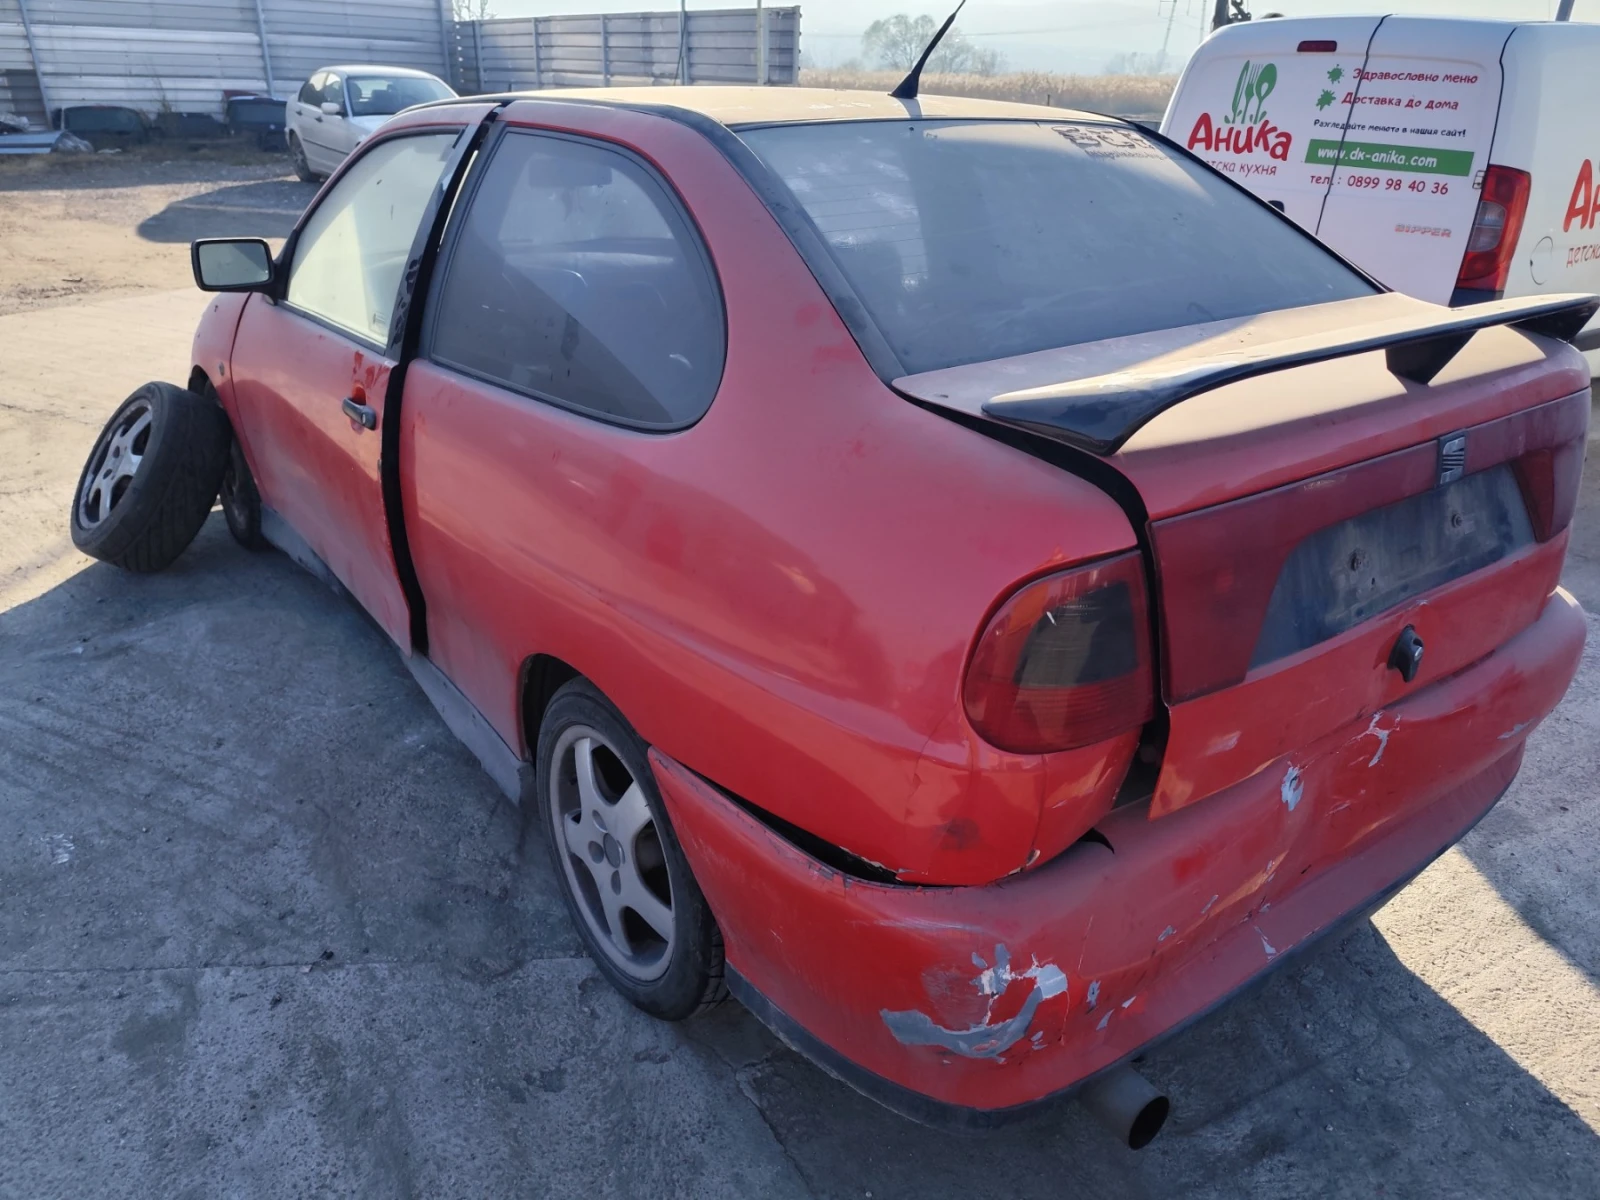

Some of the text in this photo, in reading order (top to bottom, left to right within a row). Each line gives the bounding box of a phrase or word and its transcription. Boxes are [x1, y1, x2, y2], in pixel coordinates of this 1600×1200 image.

[1353, 68, 1478, 84] Здравословно меню
[1341, 92, 1459, 110] Доставка до дома
[1187, 112, 1292, 161] Аника
[1313, 119, 1366, 131] Разгледайте
[1368, 124, 1399, 133] менюто
[1441, 128, 1466, 137] сайт!
[1317, 147, 1437, 168] www.dk-anika.com
[1239, 163, 1277, 178] кухня
[1347, 174, 1380, 189] 0899
[1385, 178, 1402, 191] 98
[1408, 180, 1426, 192] 40
[1431, 182, 1448, 195] 36
